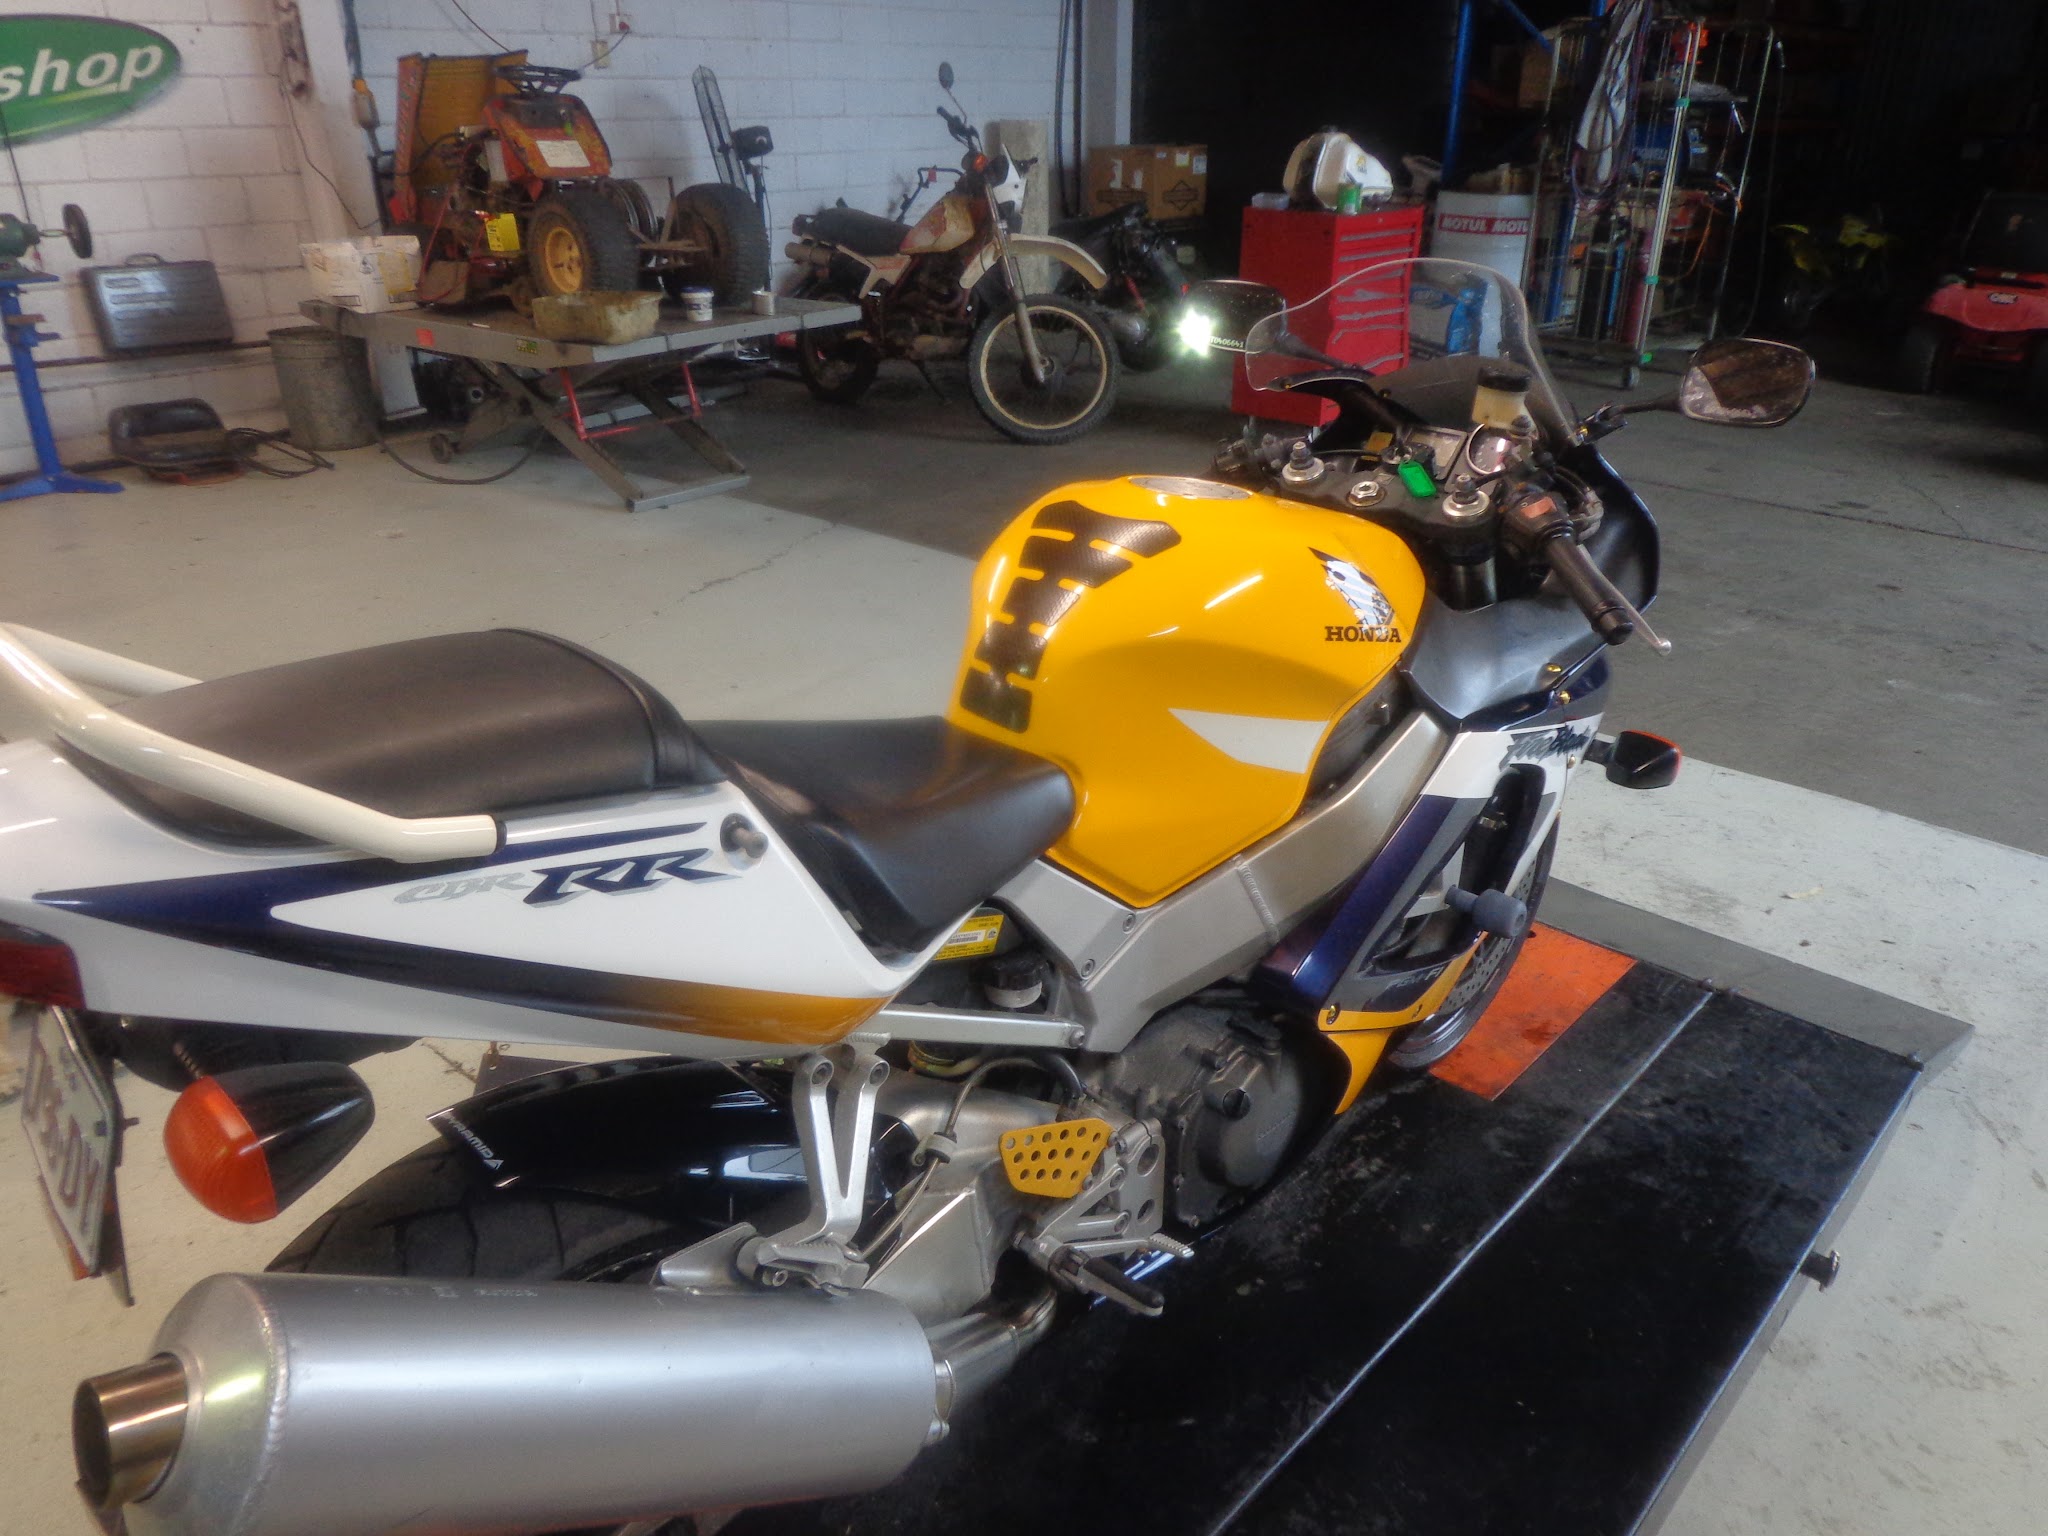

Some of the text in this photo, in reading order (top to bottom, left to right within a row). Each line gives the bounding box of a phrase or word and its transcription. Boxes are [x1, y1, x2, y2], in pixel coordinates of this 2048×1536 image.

[0, 45, 163, 101] shop
[1442, 217, 1487, 231] MOTUL
[1324, 625, 1402, 643] HONDA
[523, 847, 738, 909] RR
